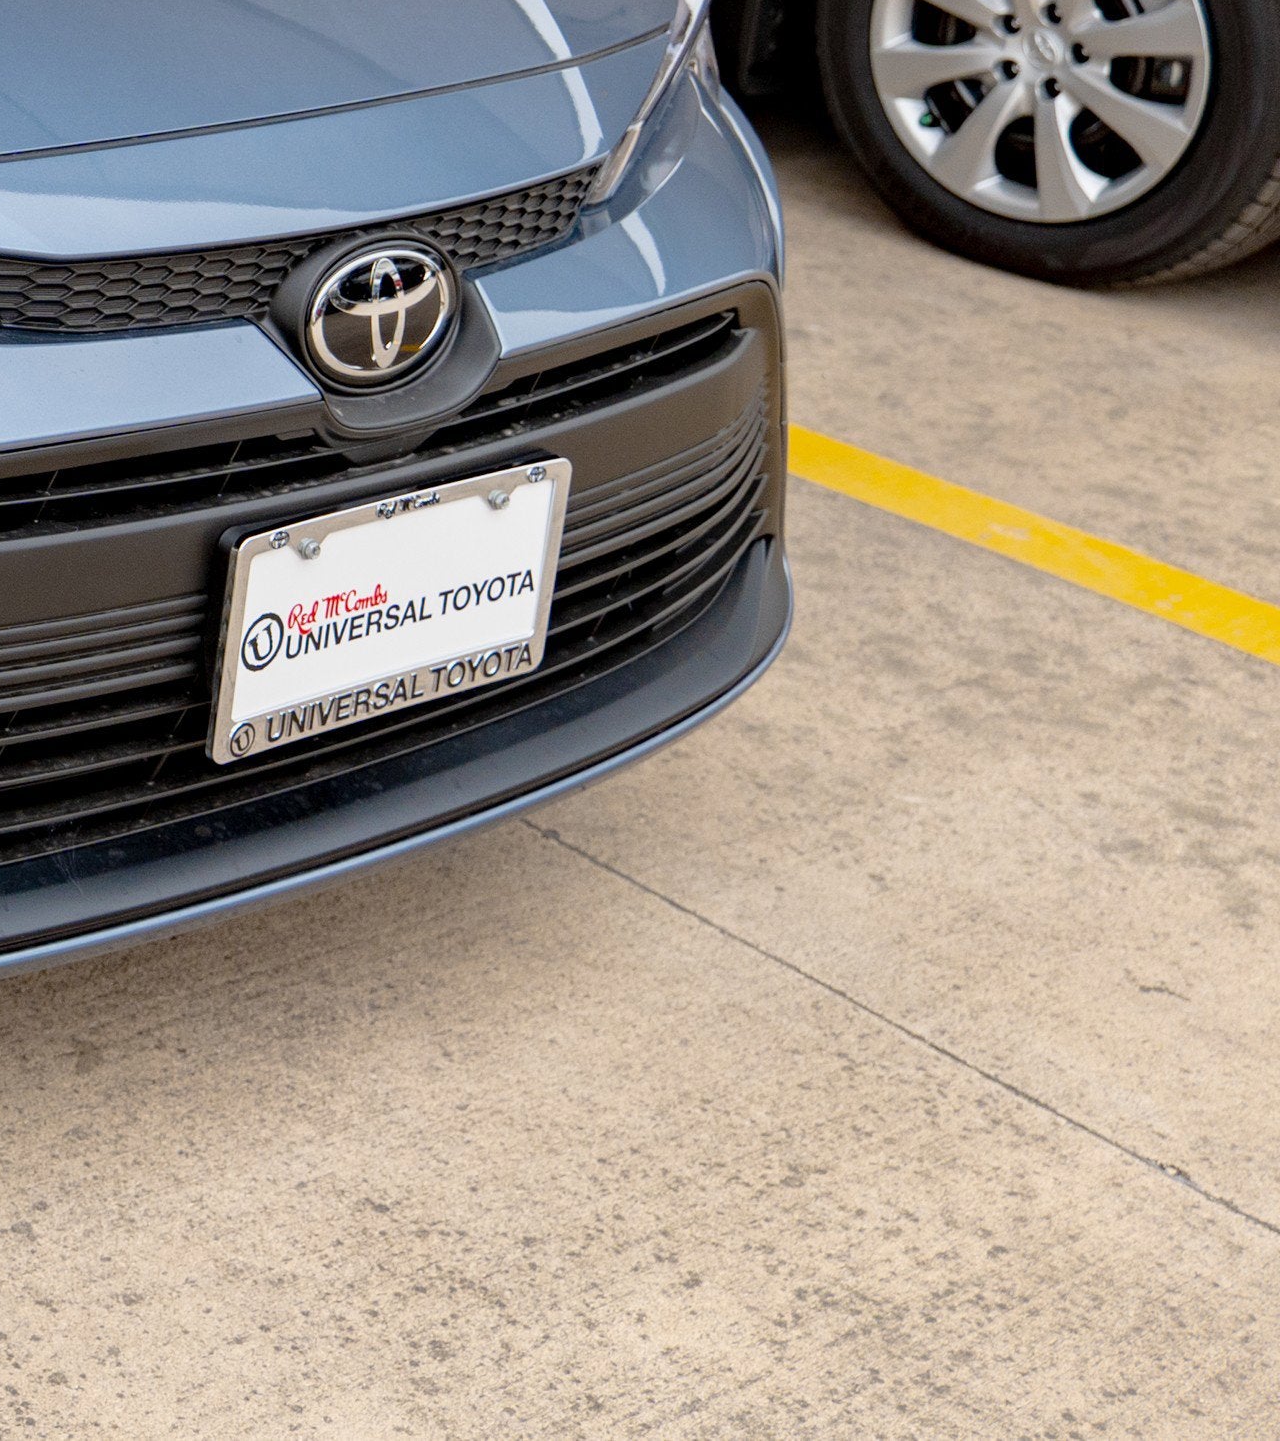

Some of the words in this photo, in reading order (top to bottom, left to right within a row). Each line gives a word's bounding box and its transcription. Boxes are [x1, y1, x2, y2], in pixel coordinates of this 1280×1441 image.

[285, 597, 432, 659] UNIVERSAL
[439, 569, 535, 616] TOYOTA
[288, 595, 318, 635] Red
[323, 584, 387, 616] McCombs
[265, 673, 425, 743] UNIVERSAL
[429, 641, 533, 693] TOYOTA
